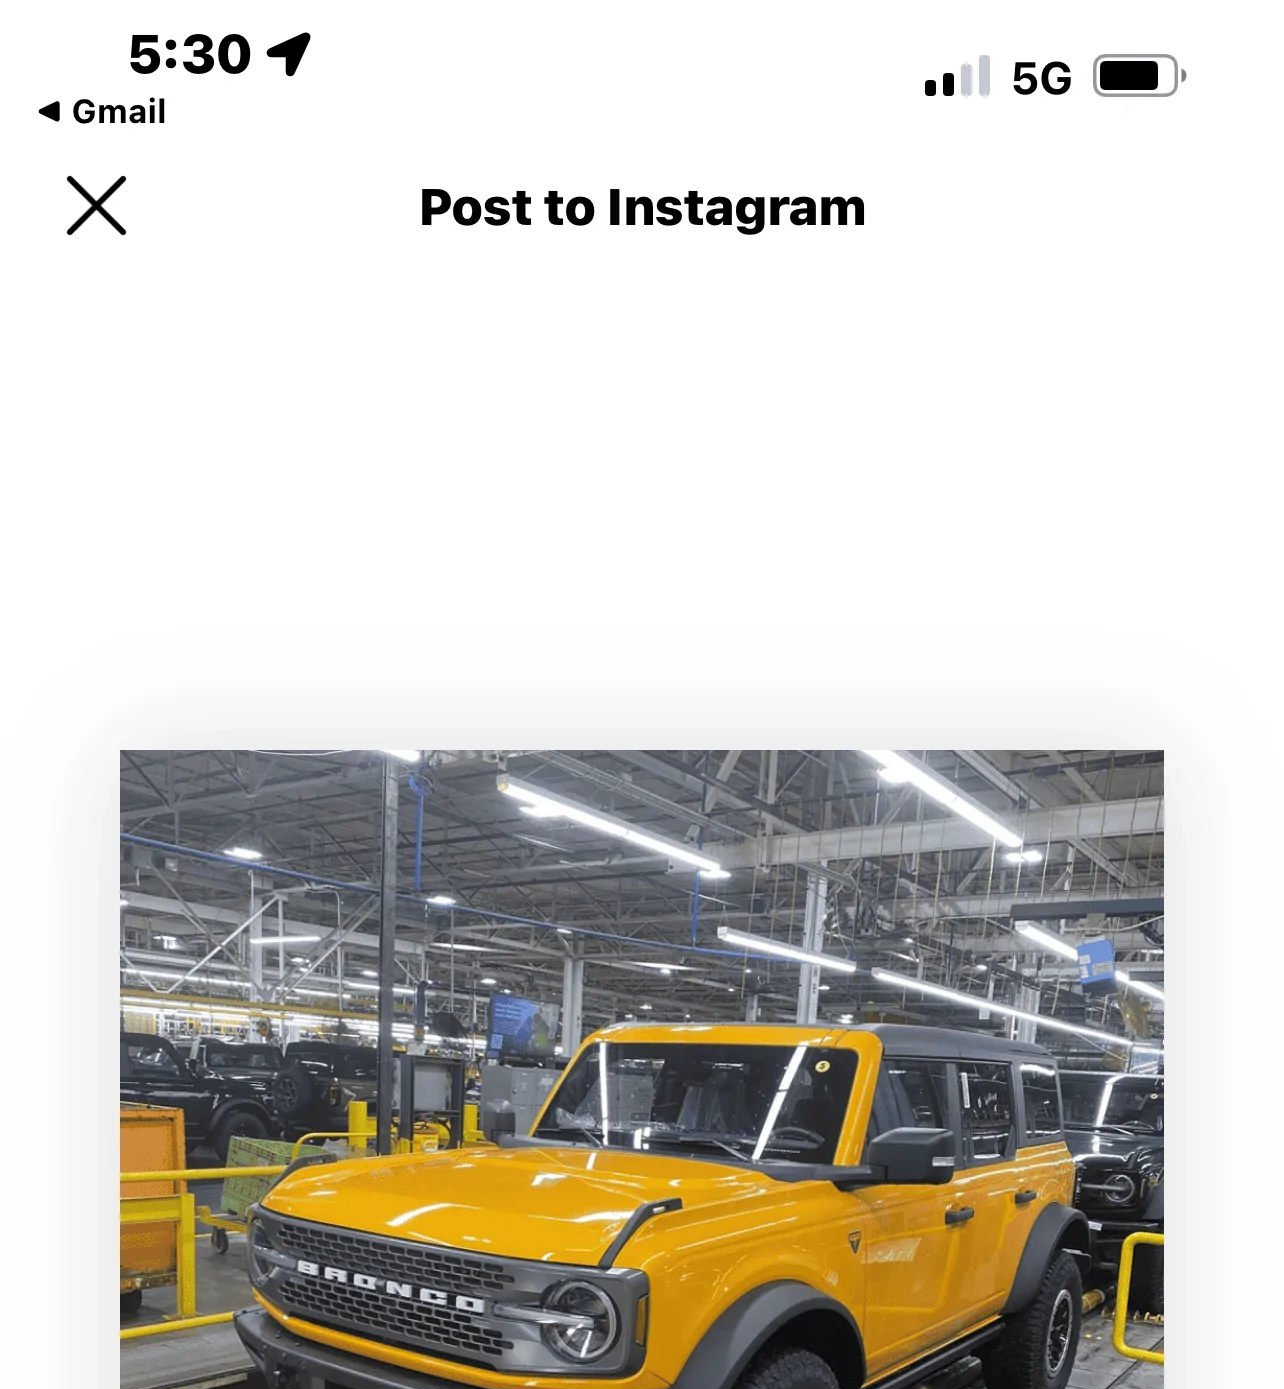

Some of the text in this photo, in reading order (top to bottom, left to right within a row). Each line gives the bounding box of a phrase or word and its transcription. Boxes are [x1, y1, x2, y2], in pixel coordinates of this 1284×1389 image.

[127, 33, 252, 76] 5:30
[1012, 60, 1073, 97] 5G
[72, 96, 166, 125] Gmail
[420, 188, 866, 236] Post to Instagram
[298, 1260, 485, 1313] BRONCO
